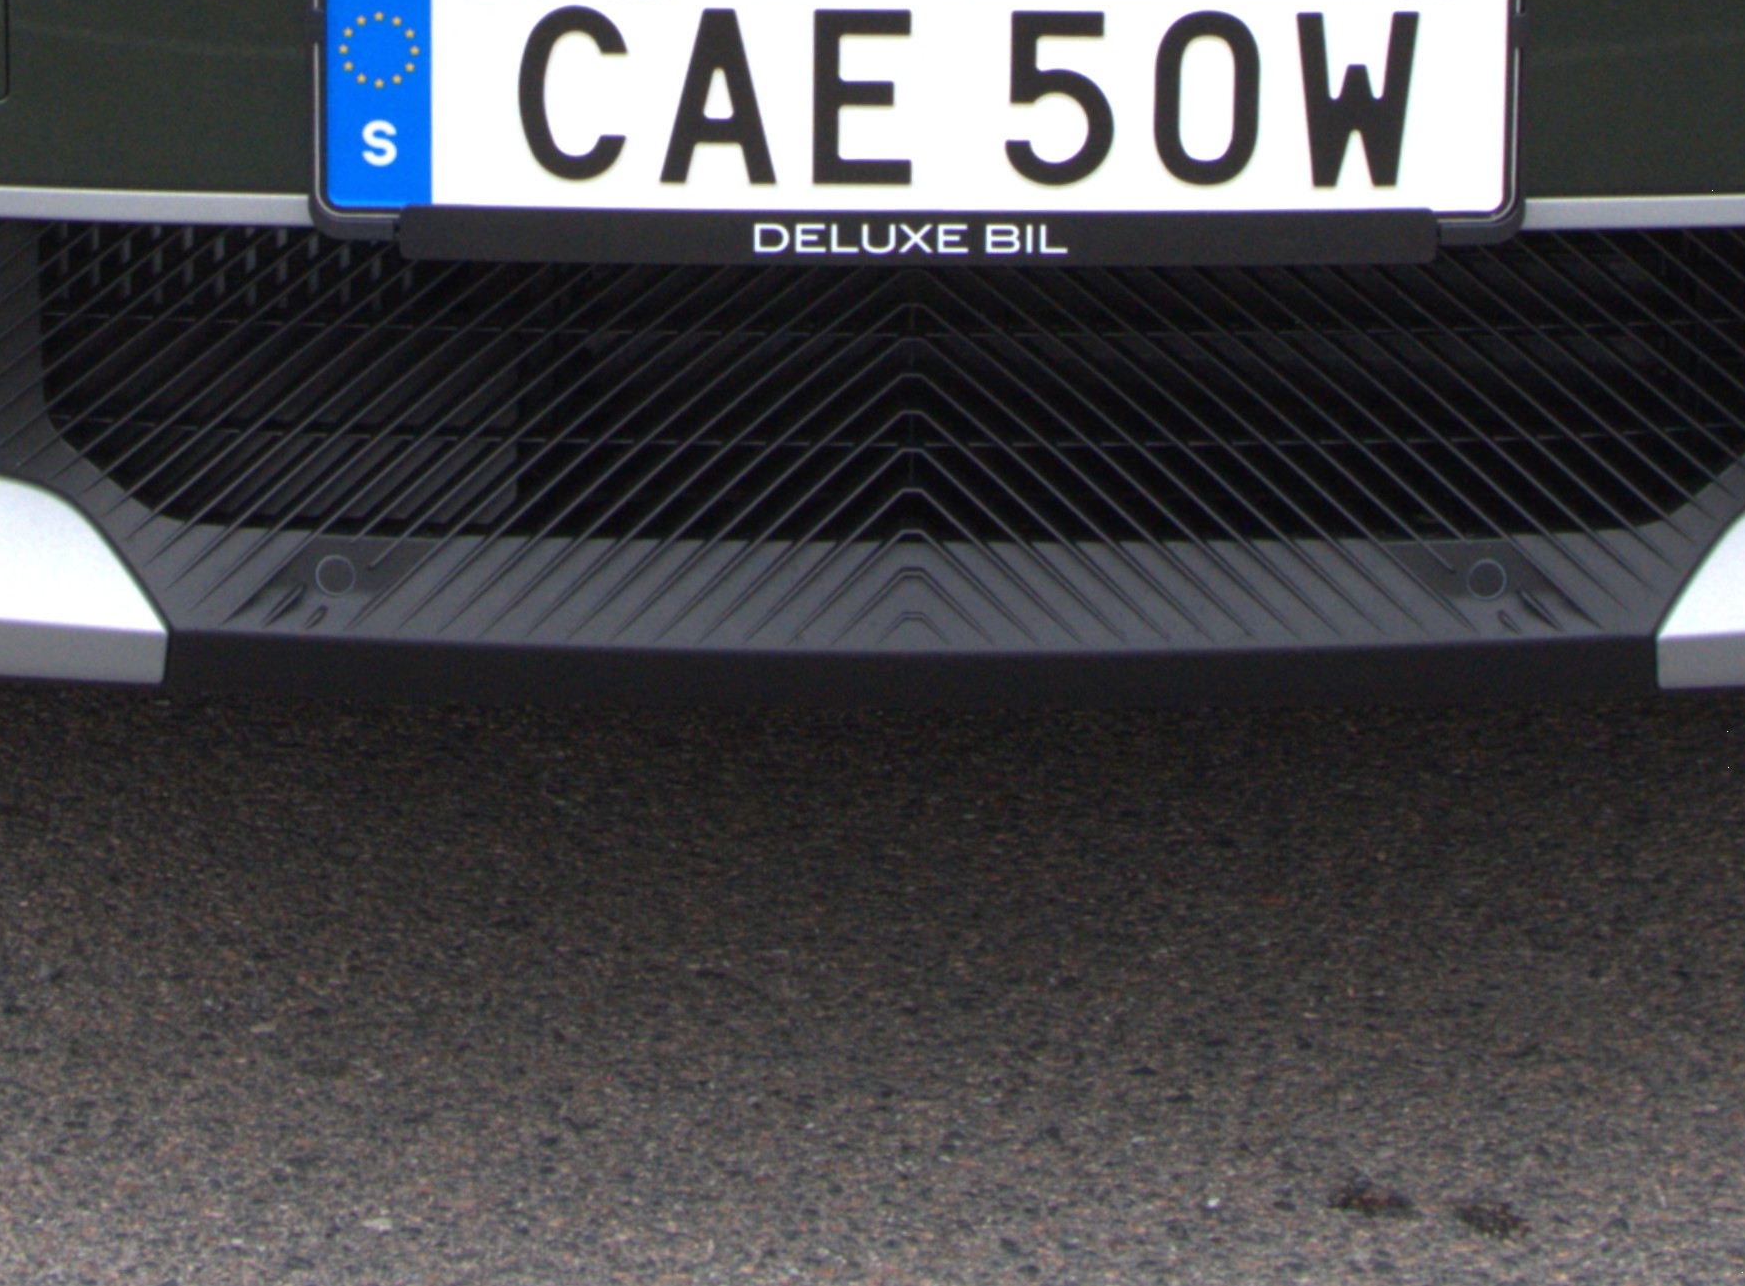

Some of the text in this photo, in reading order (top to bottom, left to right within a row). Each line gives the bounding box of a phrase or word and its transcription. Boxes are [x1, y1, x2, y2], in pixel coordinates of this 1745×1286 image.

[518, 5, 1420, 188] CAE 50W
[361, 119, 398, 167] S
[753, 223, 1068, 254] DELUXE BIL
